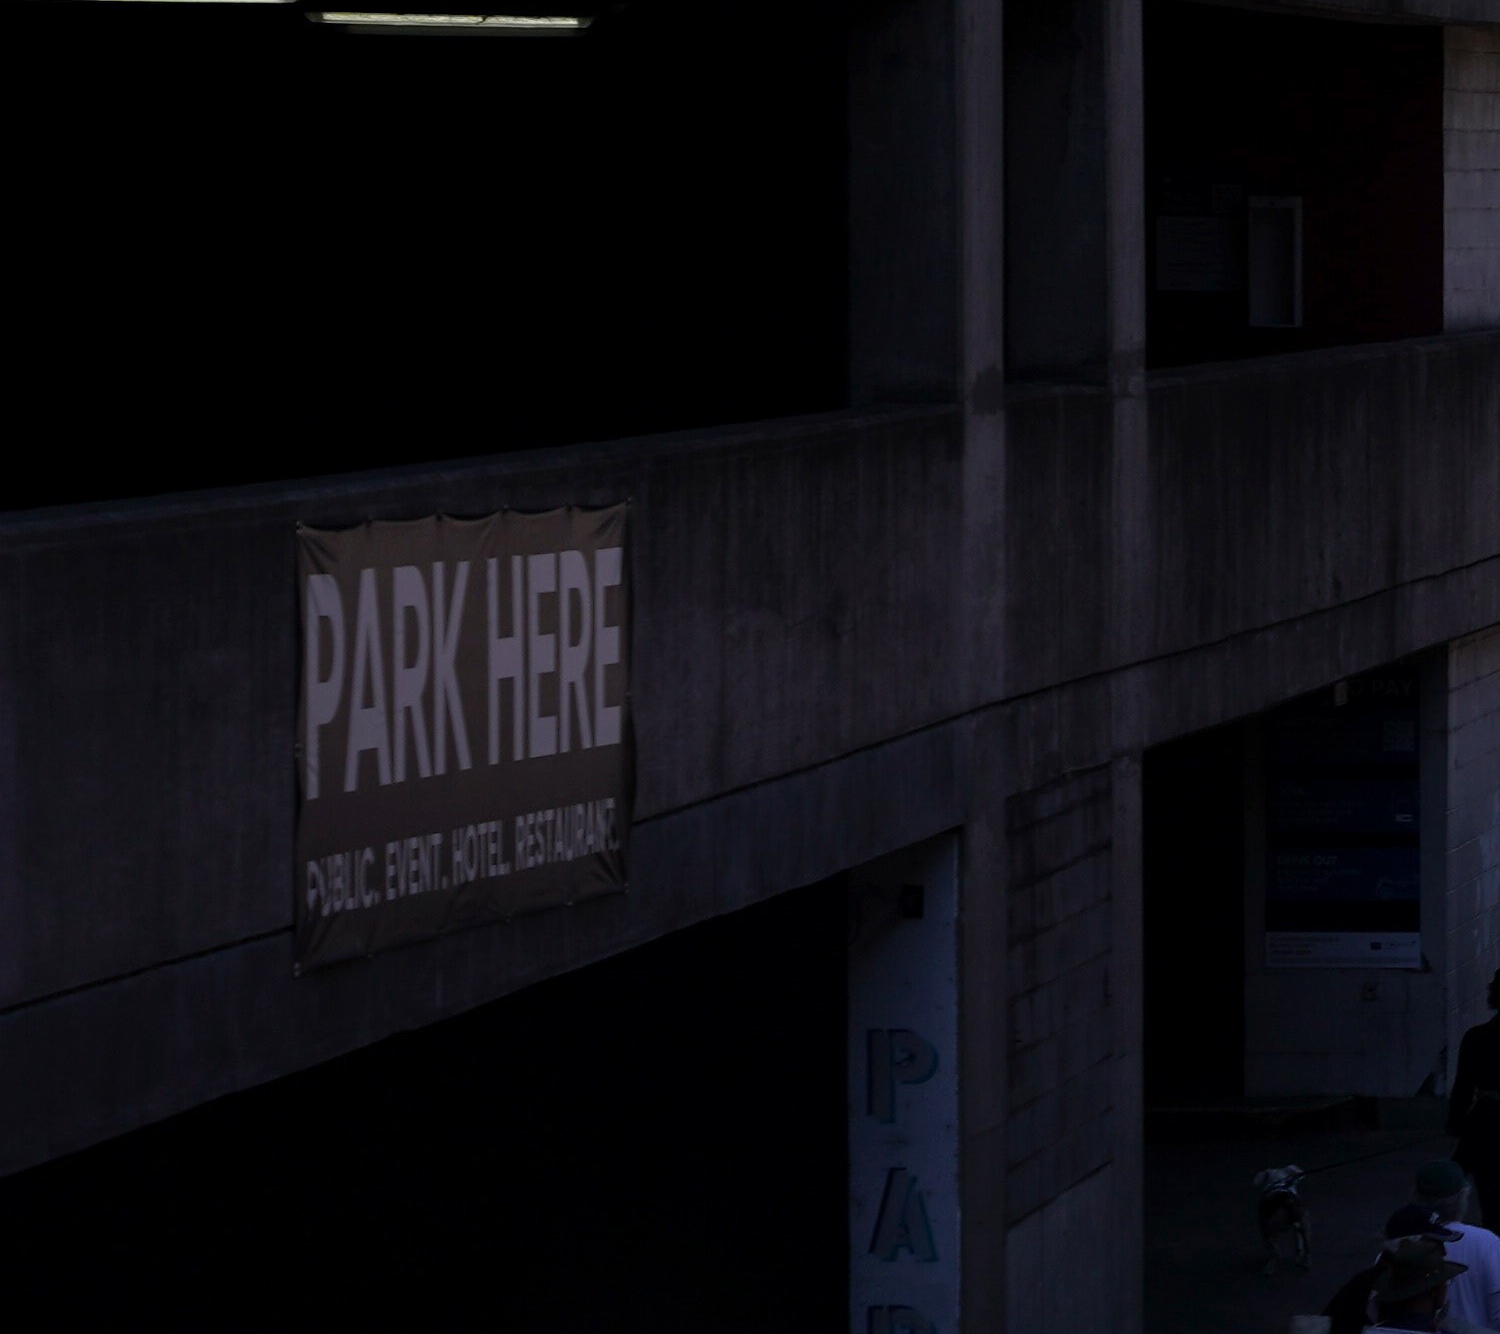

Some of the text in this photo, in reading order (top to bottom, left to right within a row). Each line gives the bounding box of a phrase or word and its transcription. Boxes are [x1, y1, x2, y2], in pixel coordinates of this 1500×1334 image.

[305, 546, 624, 800] PARK HERE
[385, 831, 448, 902] EVENT.
